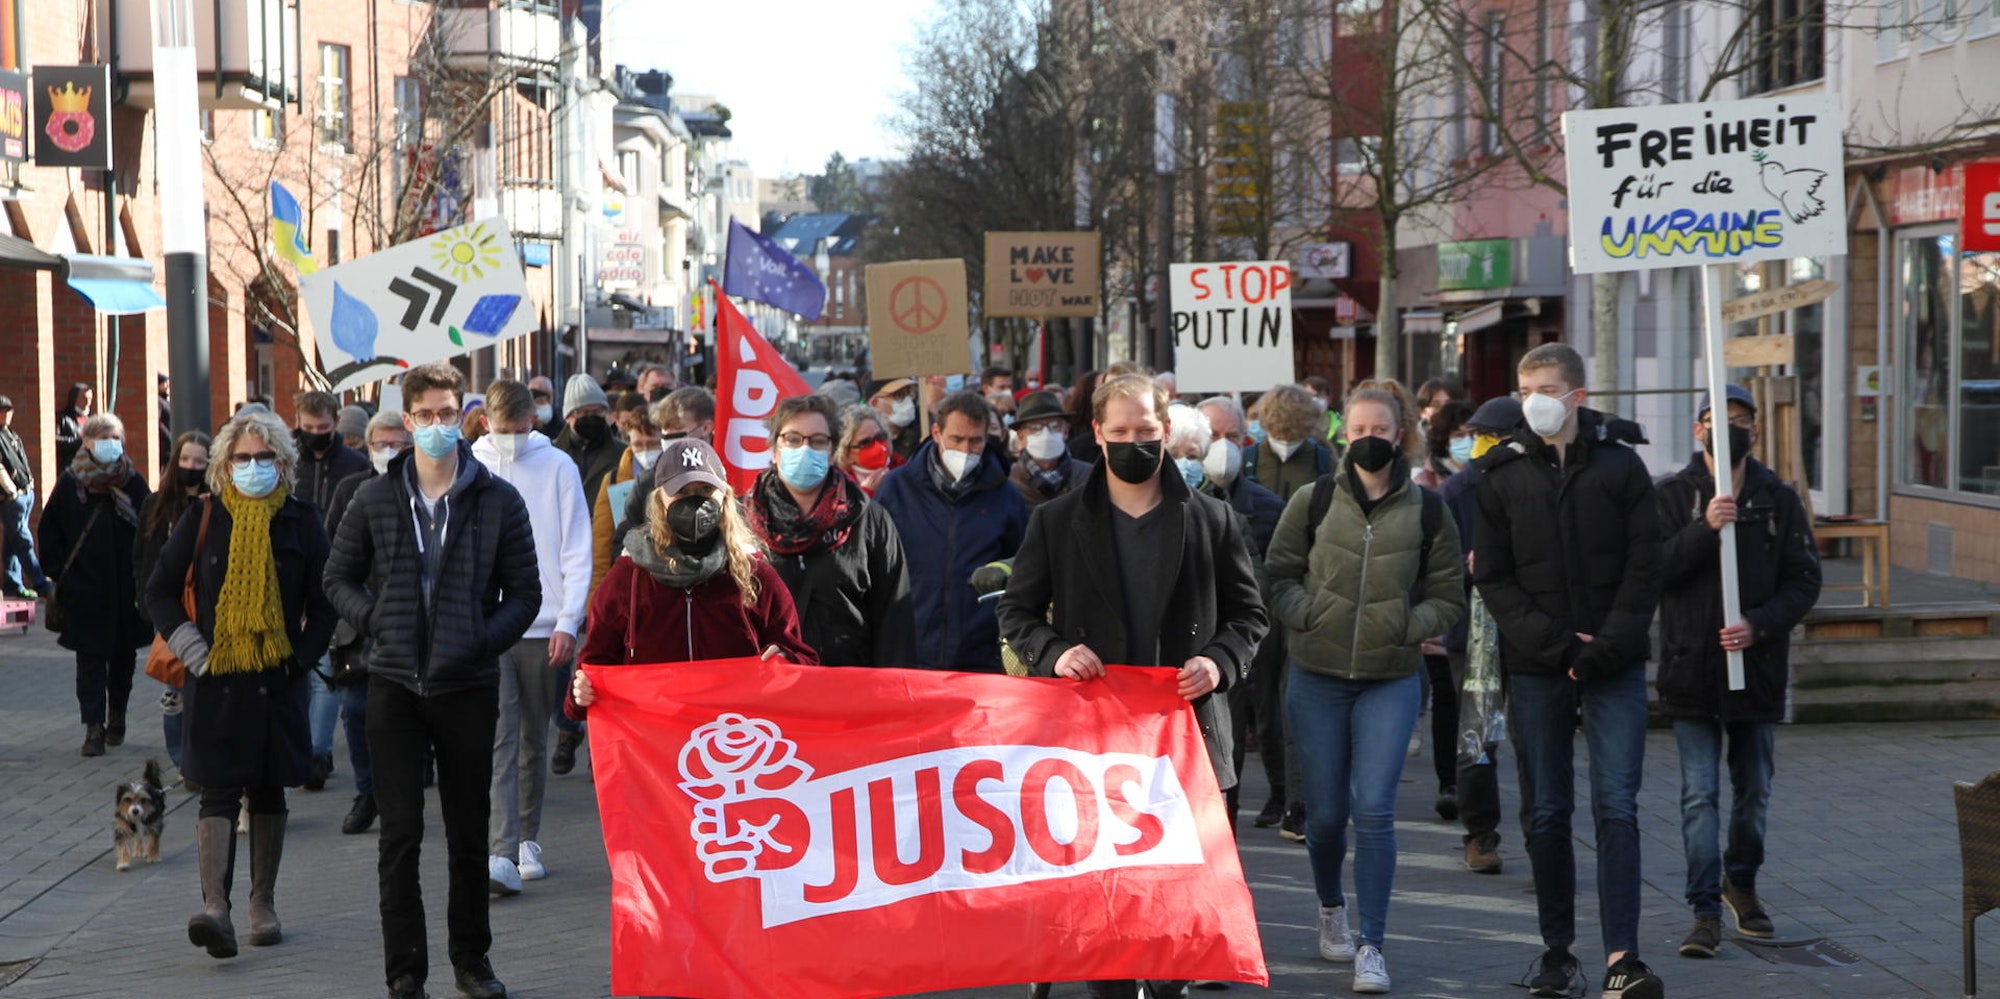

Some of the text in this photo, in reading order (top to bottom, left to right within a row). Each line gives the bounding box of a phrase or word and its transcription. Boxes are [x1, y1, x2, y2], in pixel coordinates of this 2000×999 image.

[1596, 104, 1817, 168] FREIHEIT
[1611, 170, 1735, 209] für die
[1601, 208, 1783, 259] UKRAINE
[1010, 246, 1075, 265] MAKE
[1009, 288, 1057, 308] NOT
[1190, 264, 1292, 305] STOP
[1172, 305, 1282, 350] PUTIN
[681, 447, 704, 467] NY
[803, 756, 1165, 903] JUSOS
